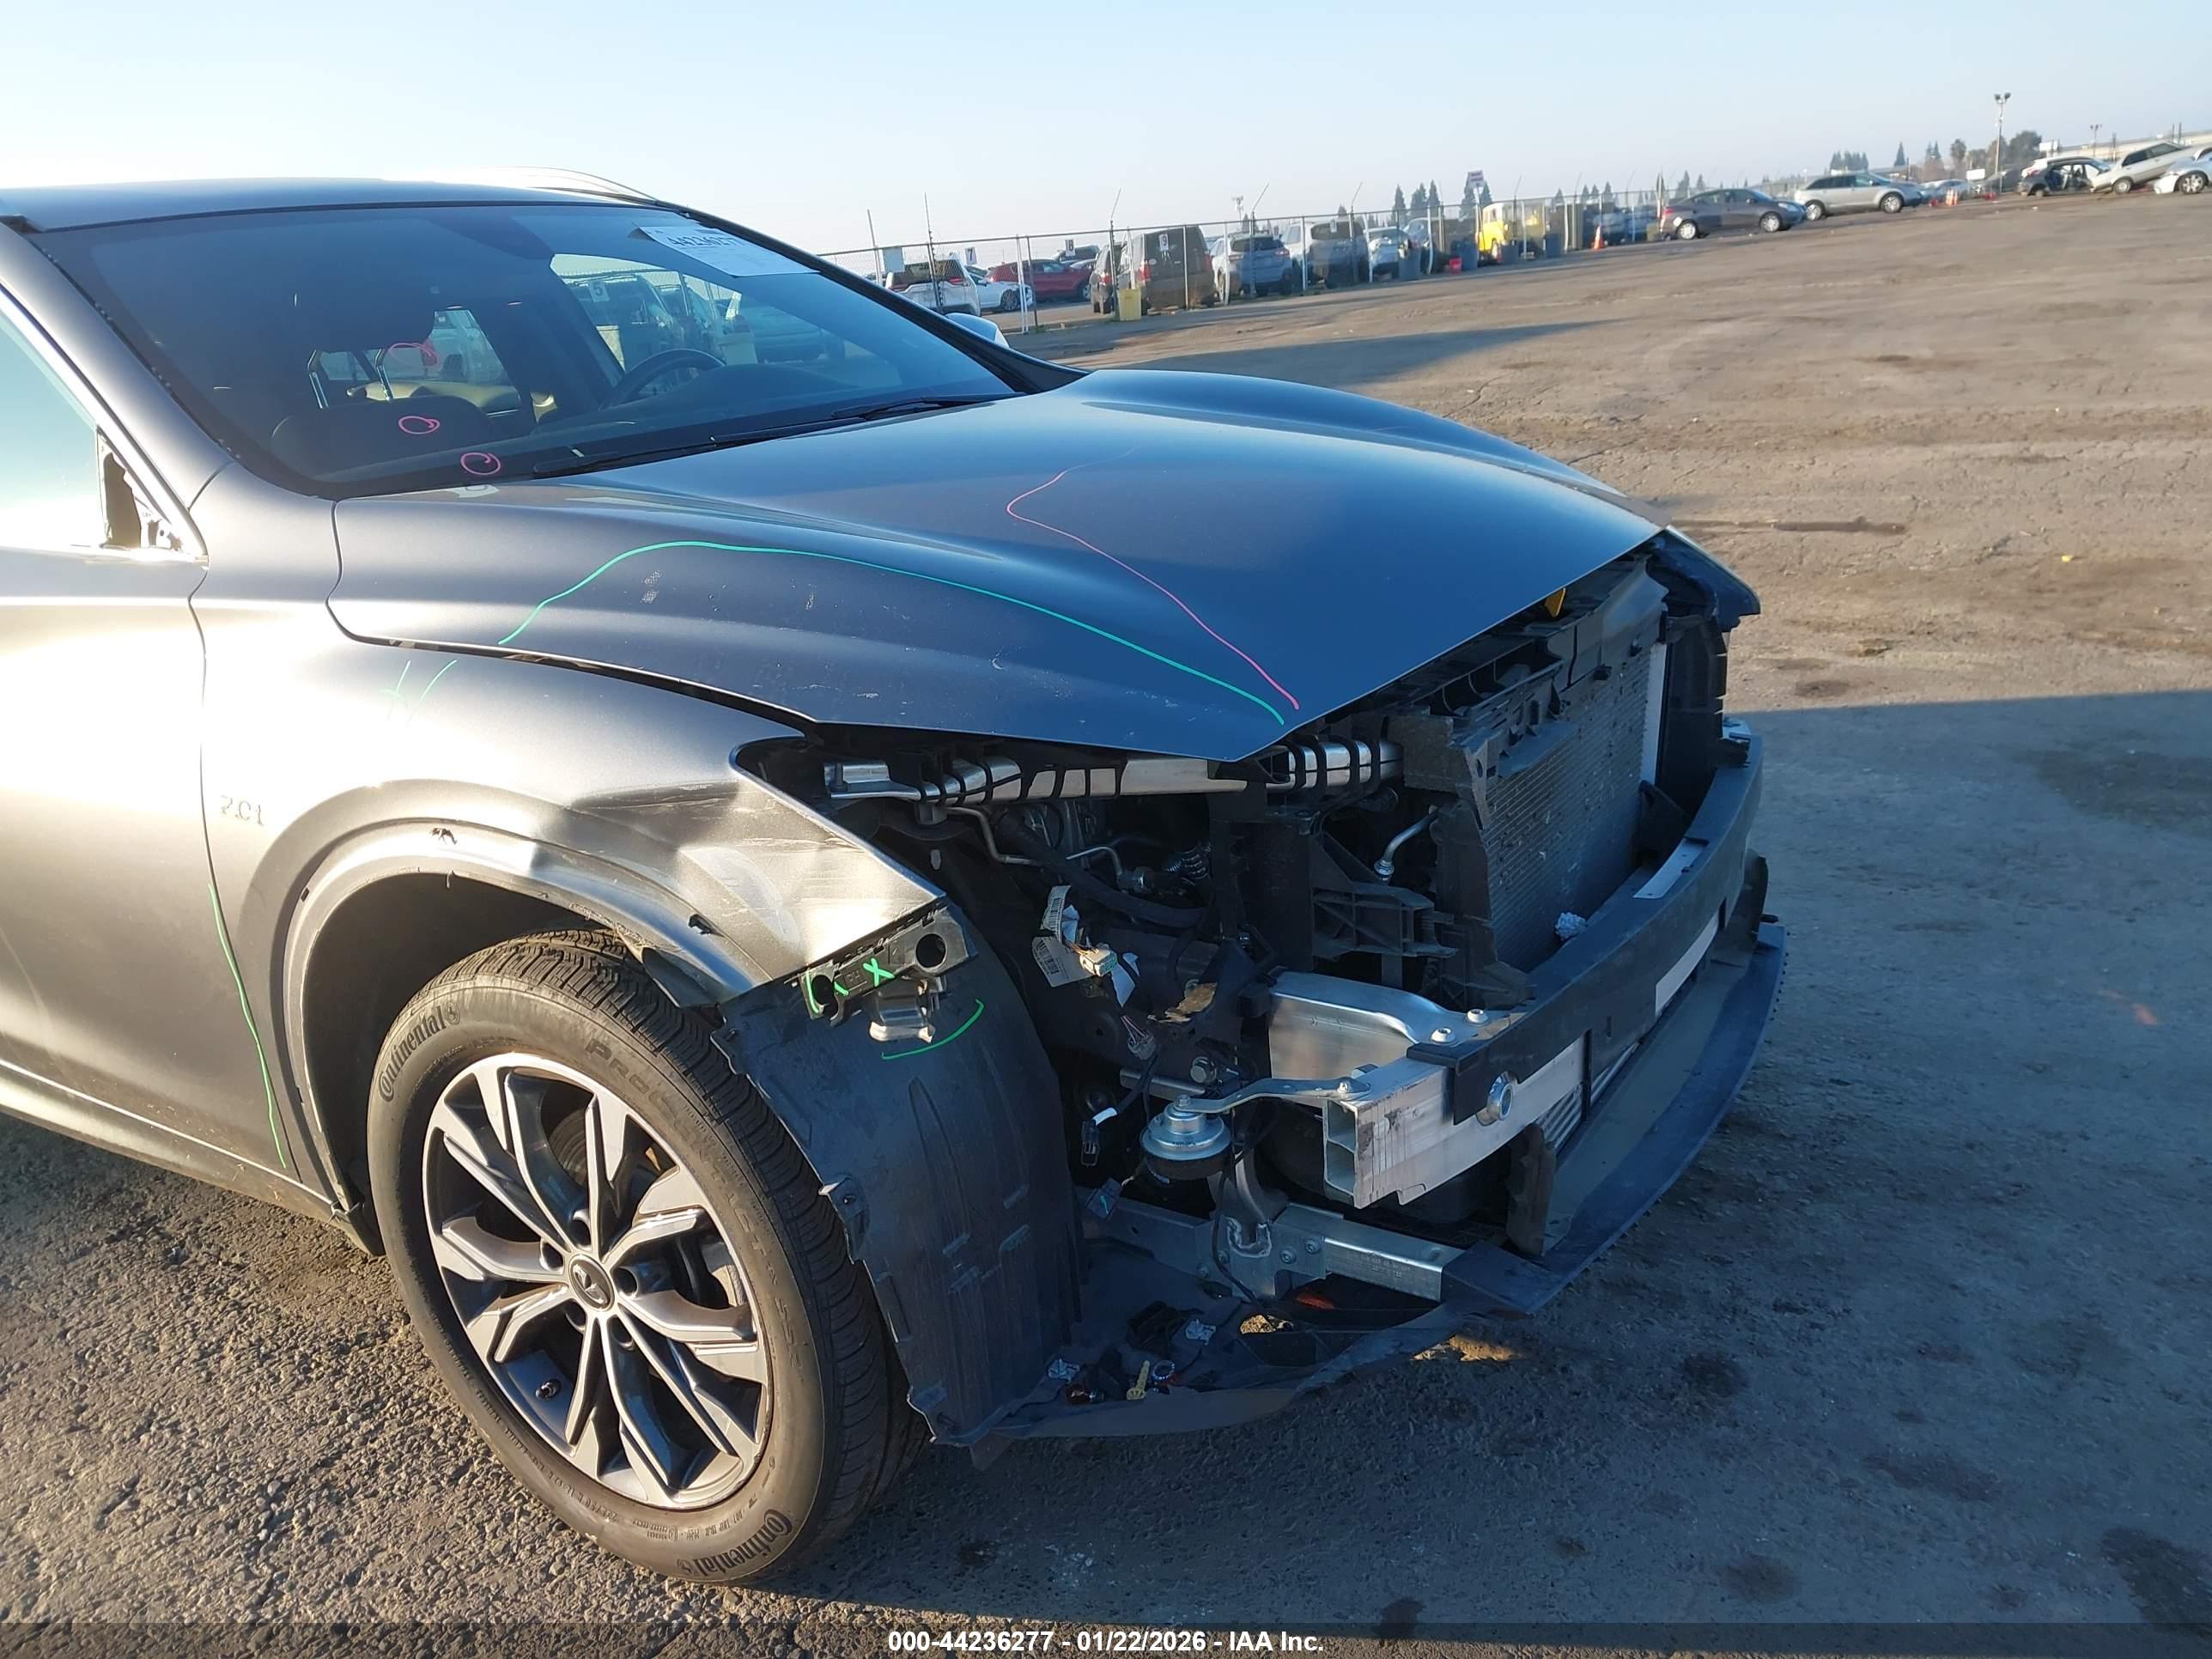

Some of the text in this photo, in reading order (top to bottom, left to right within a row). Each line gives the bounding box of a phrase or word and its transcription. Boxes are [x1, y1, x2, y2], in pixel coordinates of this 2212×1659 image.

[592, 282, 603, 296] 5
[377, 1005, 448, 1103] Continental
[692, 1508, 793, 1577] Continental
